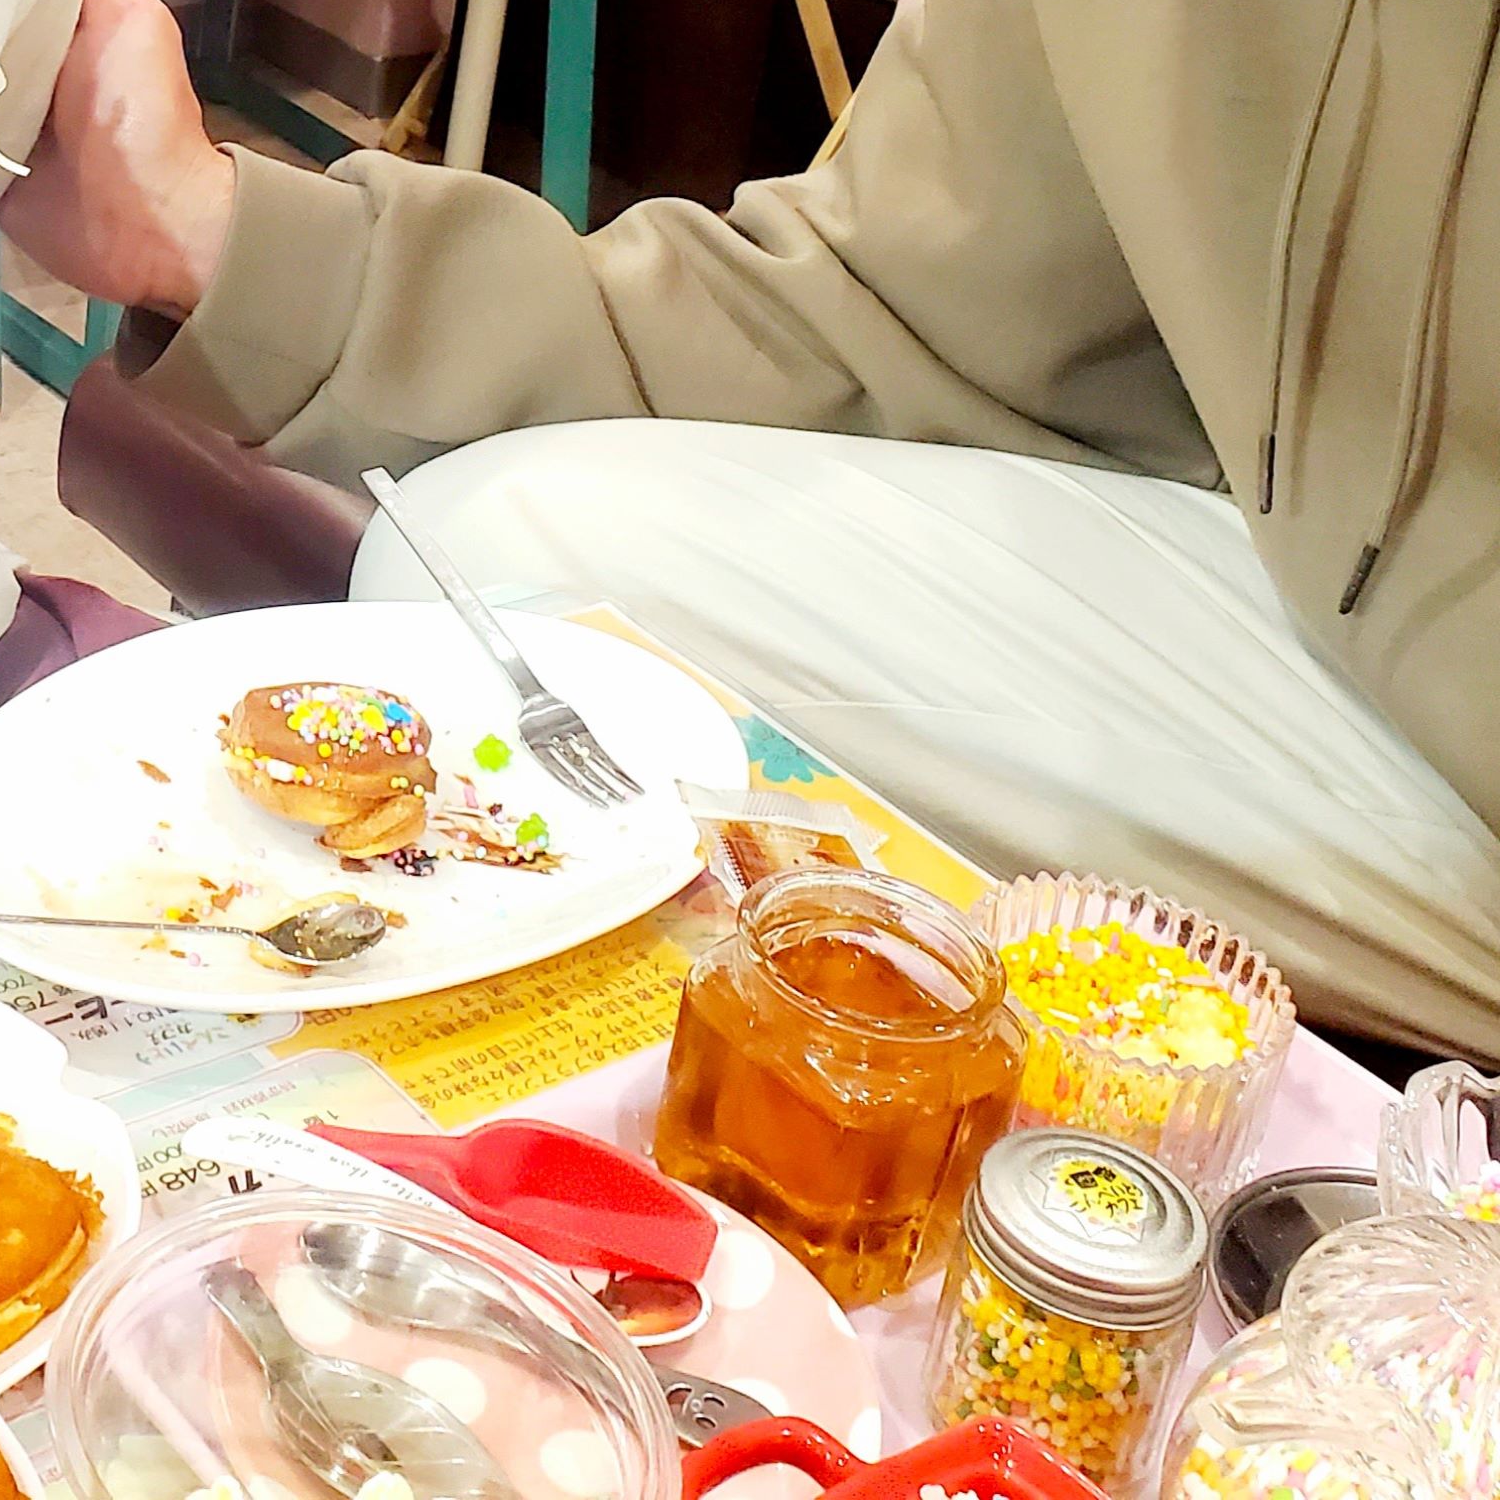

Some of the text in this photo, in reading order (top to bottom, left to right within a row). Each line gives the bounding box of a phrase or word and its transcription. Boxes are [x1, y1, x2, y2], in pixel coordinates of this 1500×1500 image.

[477, 1019, 677, 1102] 甘さ控えめブラマンジェ。
[1069, 1182, 1144, 1214] こんぺいとう
[1105, 1197, 1143, 1219] カフェ
